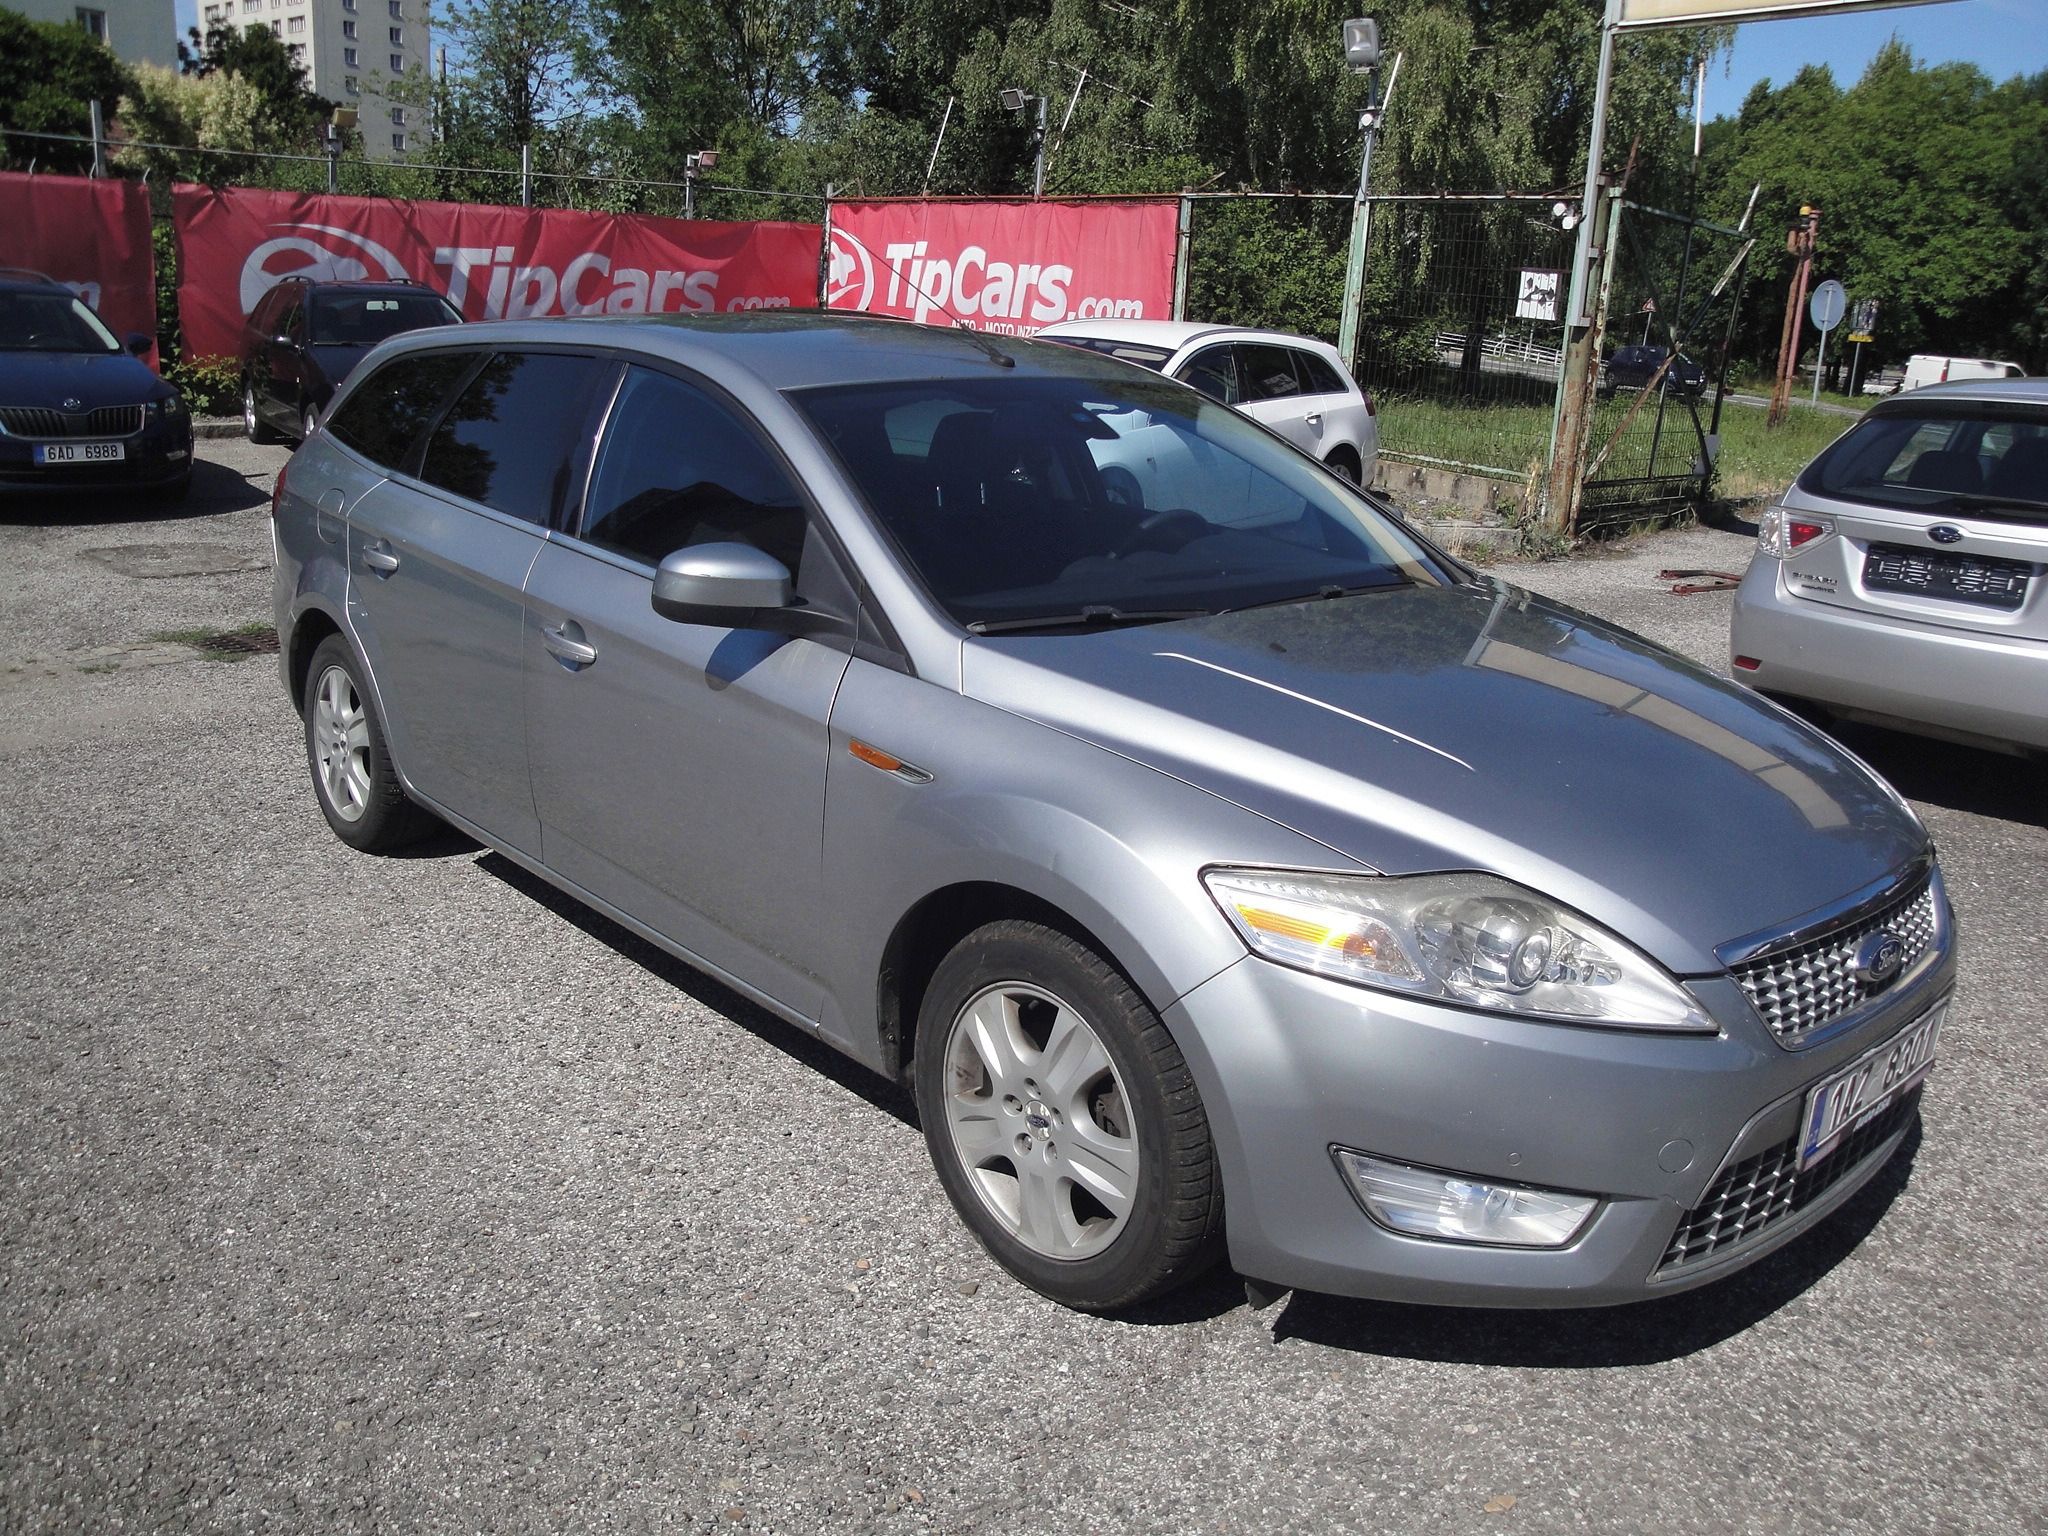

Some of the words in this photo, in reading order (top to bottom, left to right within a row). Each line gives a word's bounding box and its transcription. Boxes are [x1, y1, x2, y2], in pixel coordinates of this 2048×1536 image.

[985, 321, 1014, 335] MOTO
[48, 446, 74, 460] 6AD
[84, 445, 118, 459] 6988
